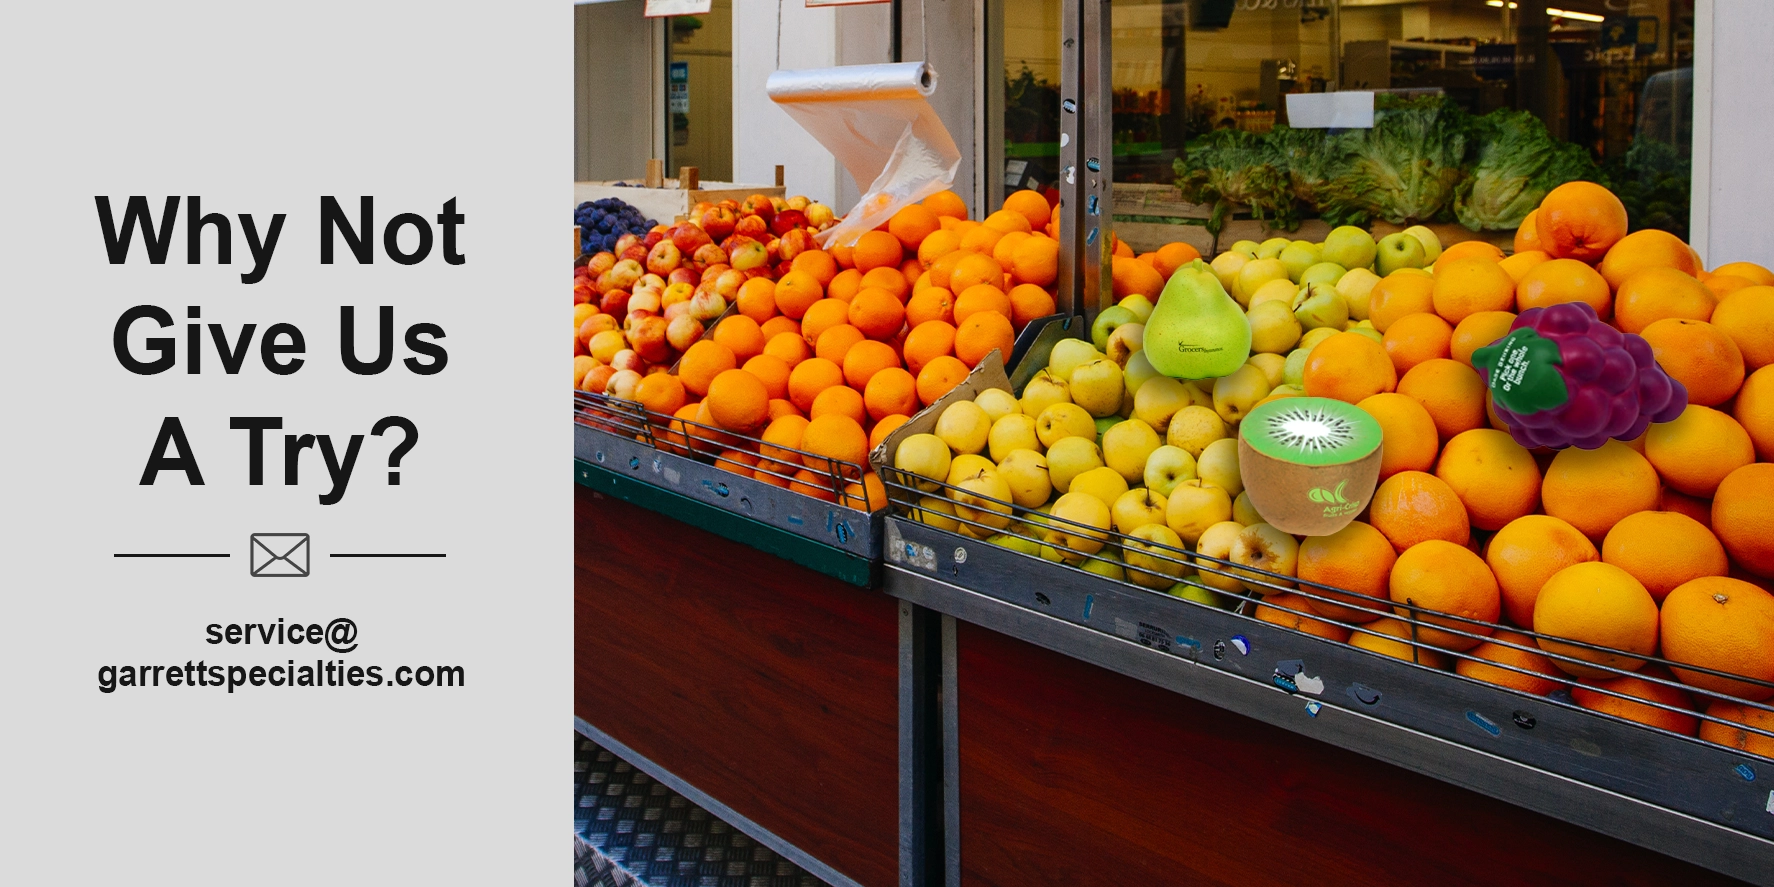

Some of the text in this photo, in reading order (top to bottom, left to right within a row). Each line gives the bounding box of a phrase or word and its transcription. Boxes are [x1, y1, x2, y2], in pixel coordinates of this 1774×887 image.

[1500, 364, 1512, 382] Pick
[1502, 346, 1528, 392] Or the whole
[1513, 360, 1530, 385] bunch.
